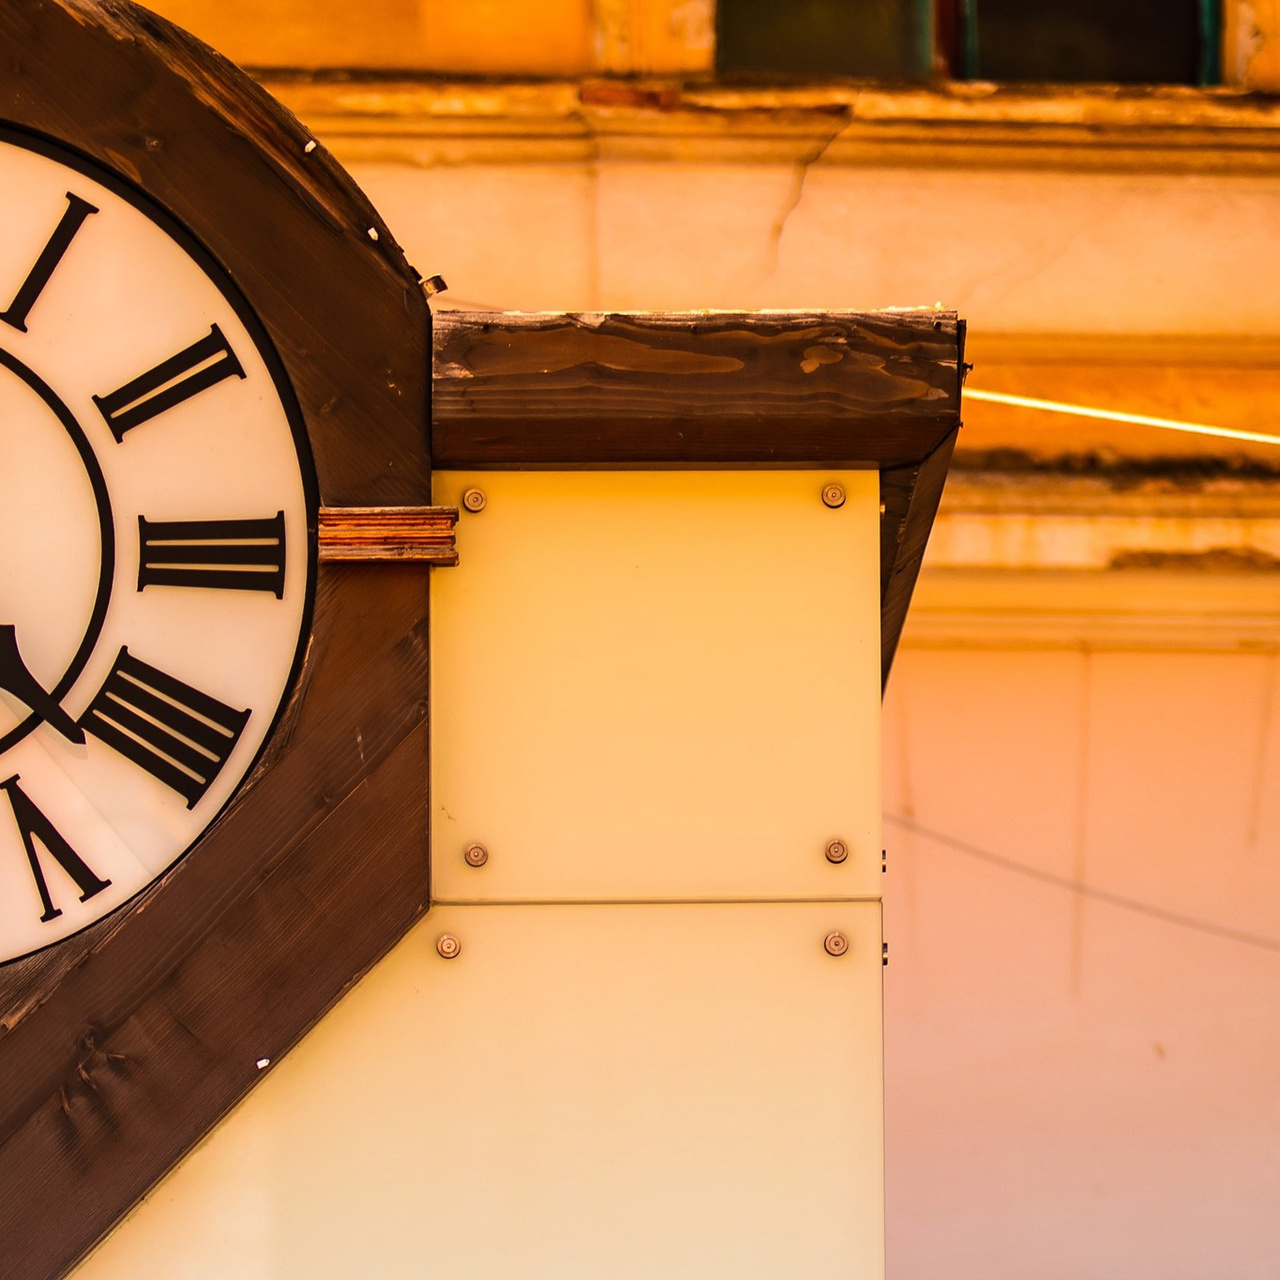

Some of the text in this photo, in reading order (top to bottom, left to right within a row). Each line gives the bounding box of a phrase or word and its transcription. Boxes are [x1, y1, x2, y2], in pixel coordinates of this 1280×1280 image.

[91, 323, 246, 443] II
[137, 511, 286, 600] III
[77, 645, 252, 810] IIII
[0, 774, 111, 922] V
